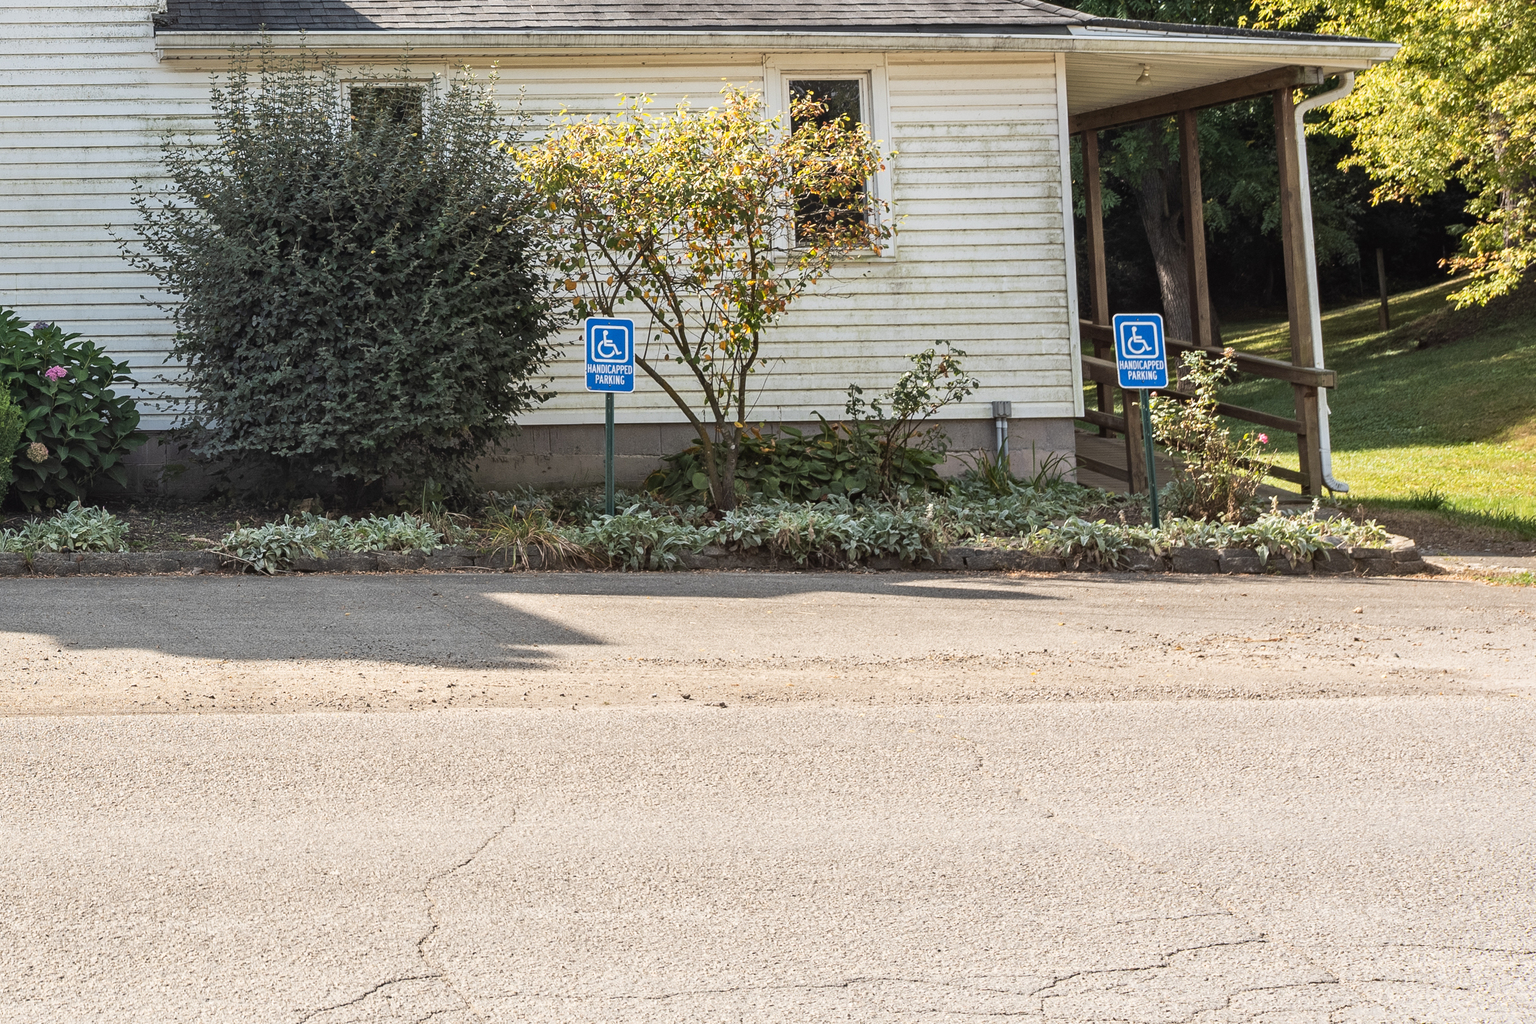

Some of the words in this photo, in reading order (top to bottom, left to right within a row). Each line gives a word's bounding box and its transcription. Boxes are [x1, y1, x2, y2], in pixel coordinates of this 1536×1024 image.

[587, 364, 633, 375] HANDICAPPED
[1119, 360, 1164, 370] HANDICAPPED
[595, 375, 625, 385] PARKING
[1127, 370, 1158, 380] PARKING
